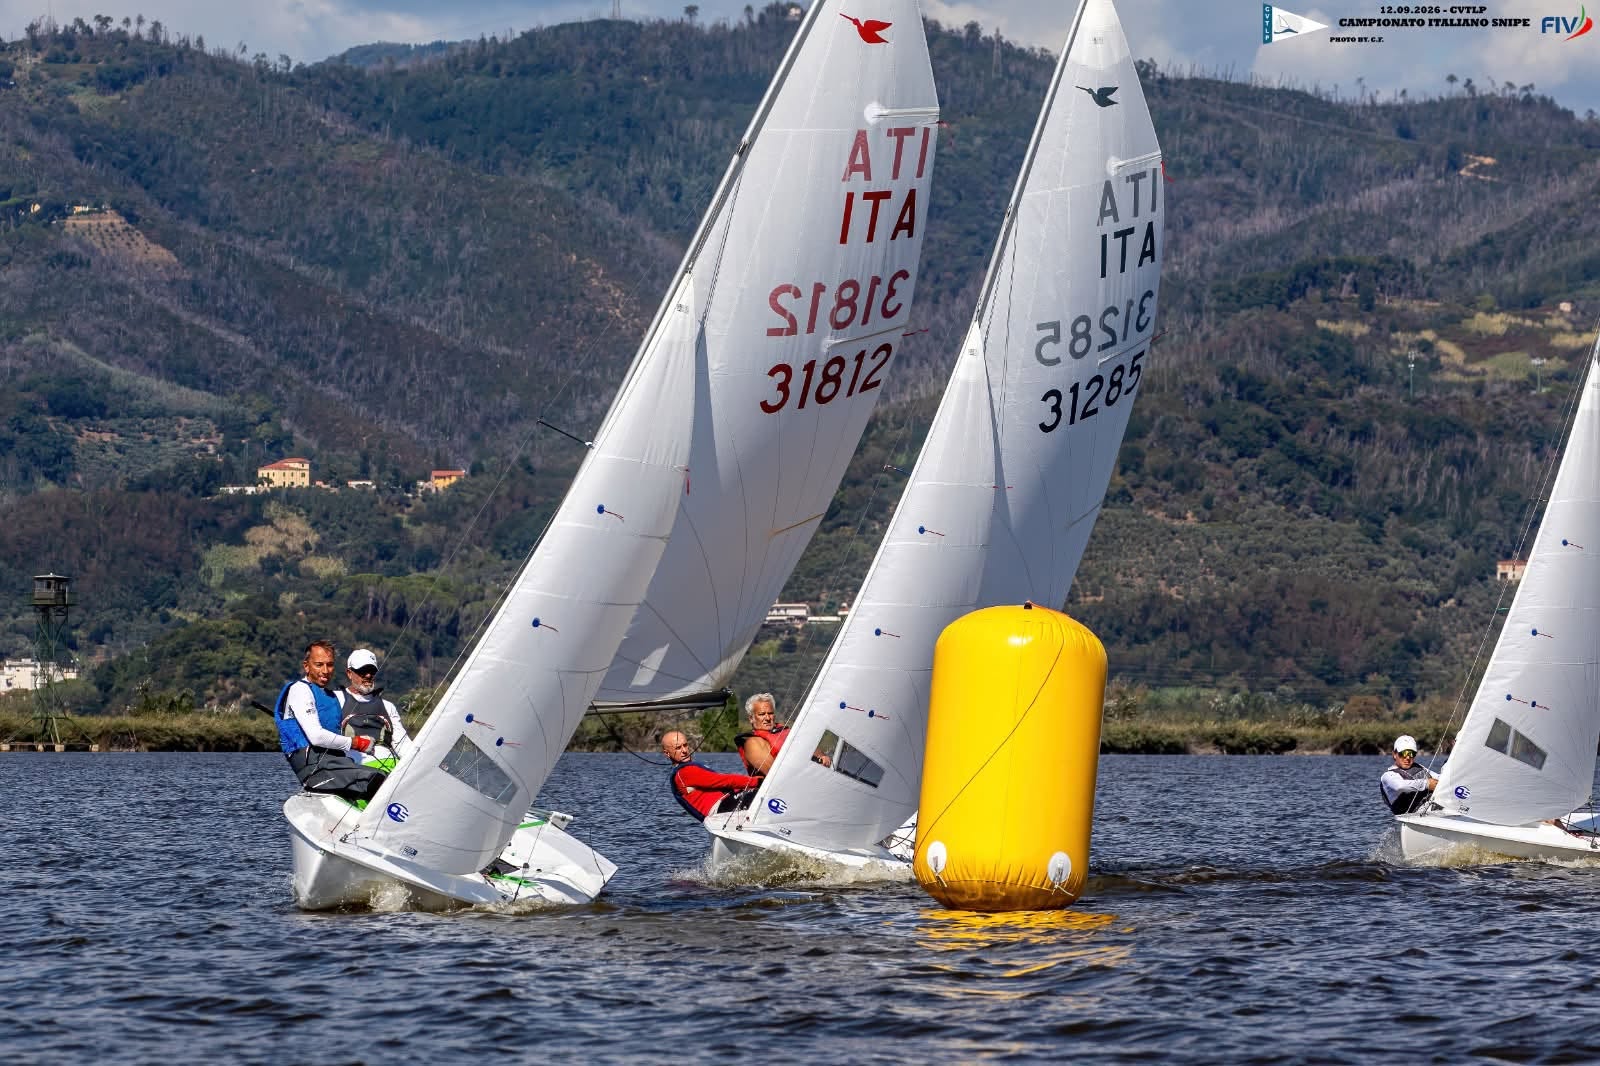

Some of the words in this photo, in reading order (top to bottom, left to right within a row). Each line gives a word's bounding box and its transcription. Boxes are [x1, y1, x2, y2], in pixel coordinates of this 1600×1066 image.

[839, 188, 917, 245] ITA
[1100, 221, 1156, 278] ITA
[759, 342, 893, 414] 31812
[1038, 349, 1145, 433] 31285
